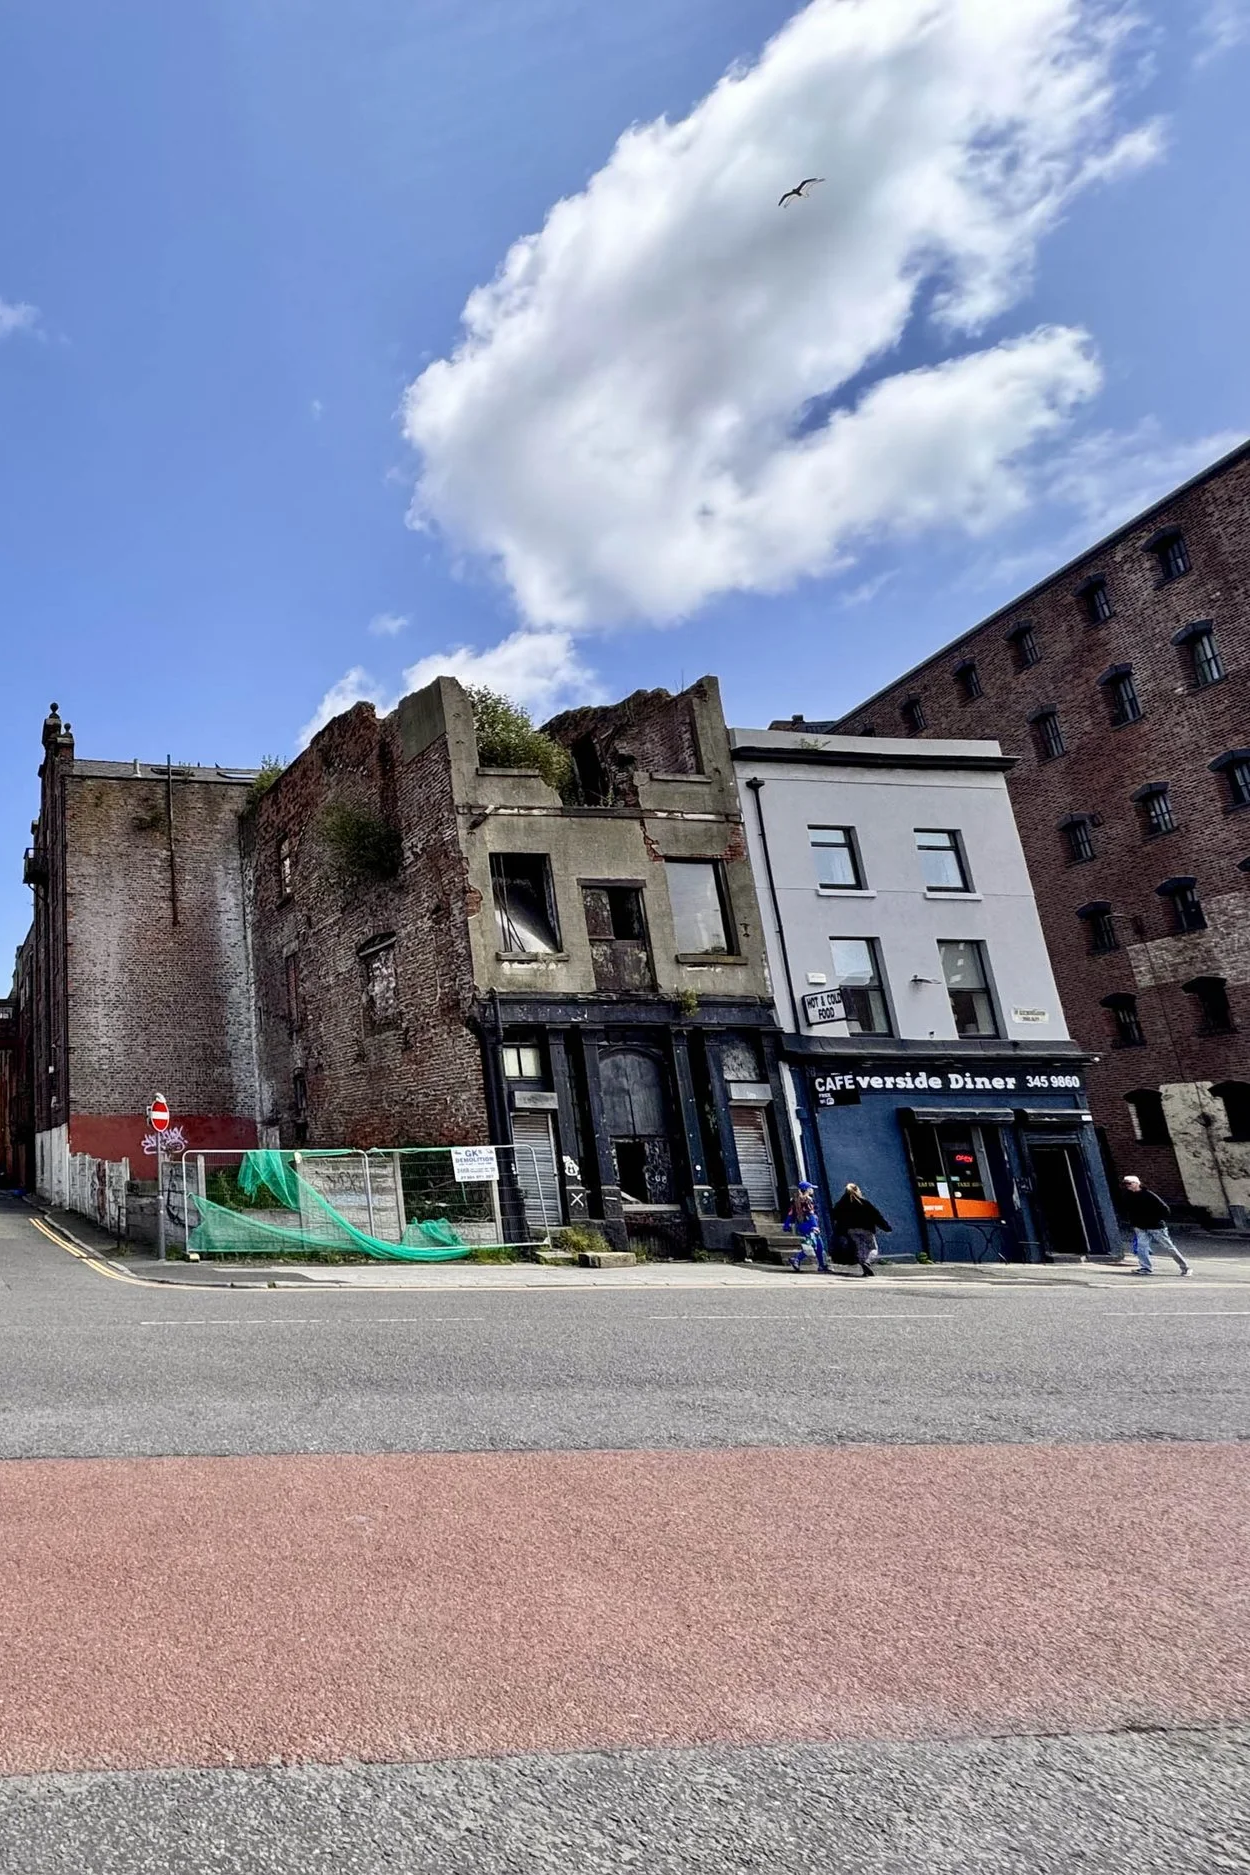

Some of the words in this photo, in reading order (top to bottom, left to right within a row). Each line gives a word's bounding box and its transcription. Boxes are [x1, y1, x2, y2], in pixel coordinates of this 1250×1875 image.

[807, 997, 818, 1008] HOT
[820, 995, 825, 1006] &
[827, 993, 842, 1005] COLD
[818, 1007, 835, 1019] FOOD
[856, 1072, 943, 1089] verside
[948, 1072, 1017, 1089] Diner
[1026, 1075, 1049, 1088] 345
[1050, 1075, 1080, 1088] 9860
